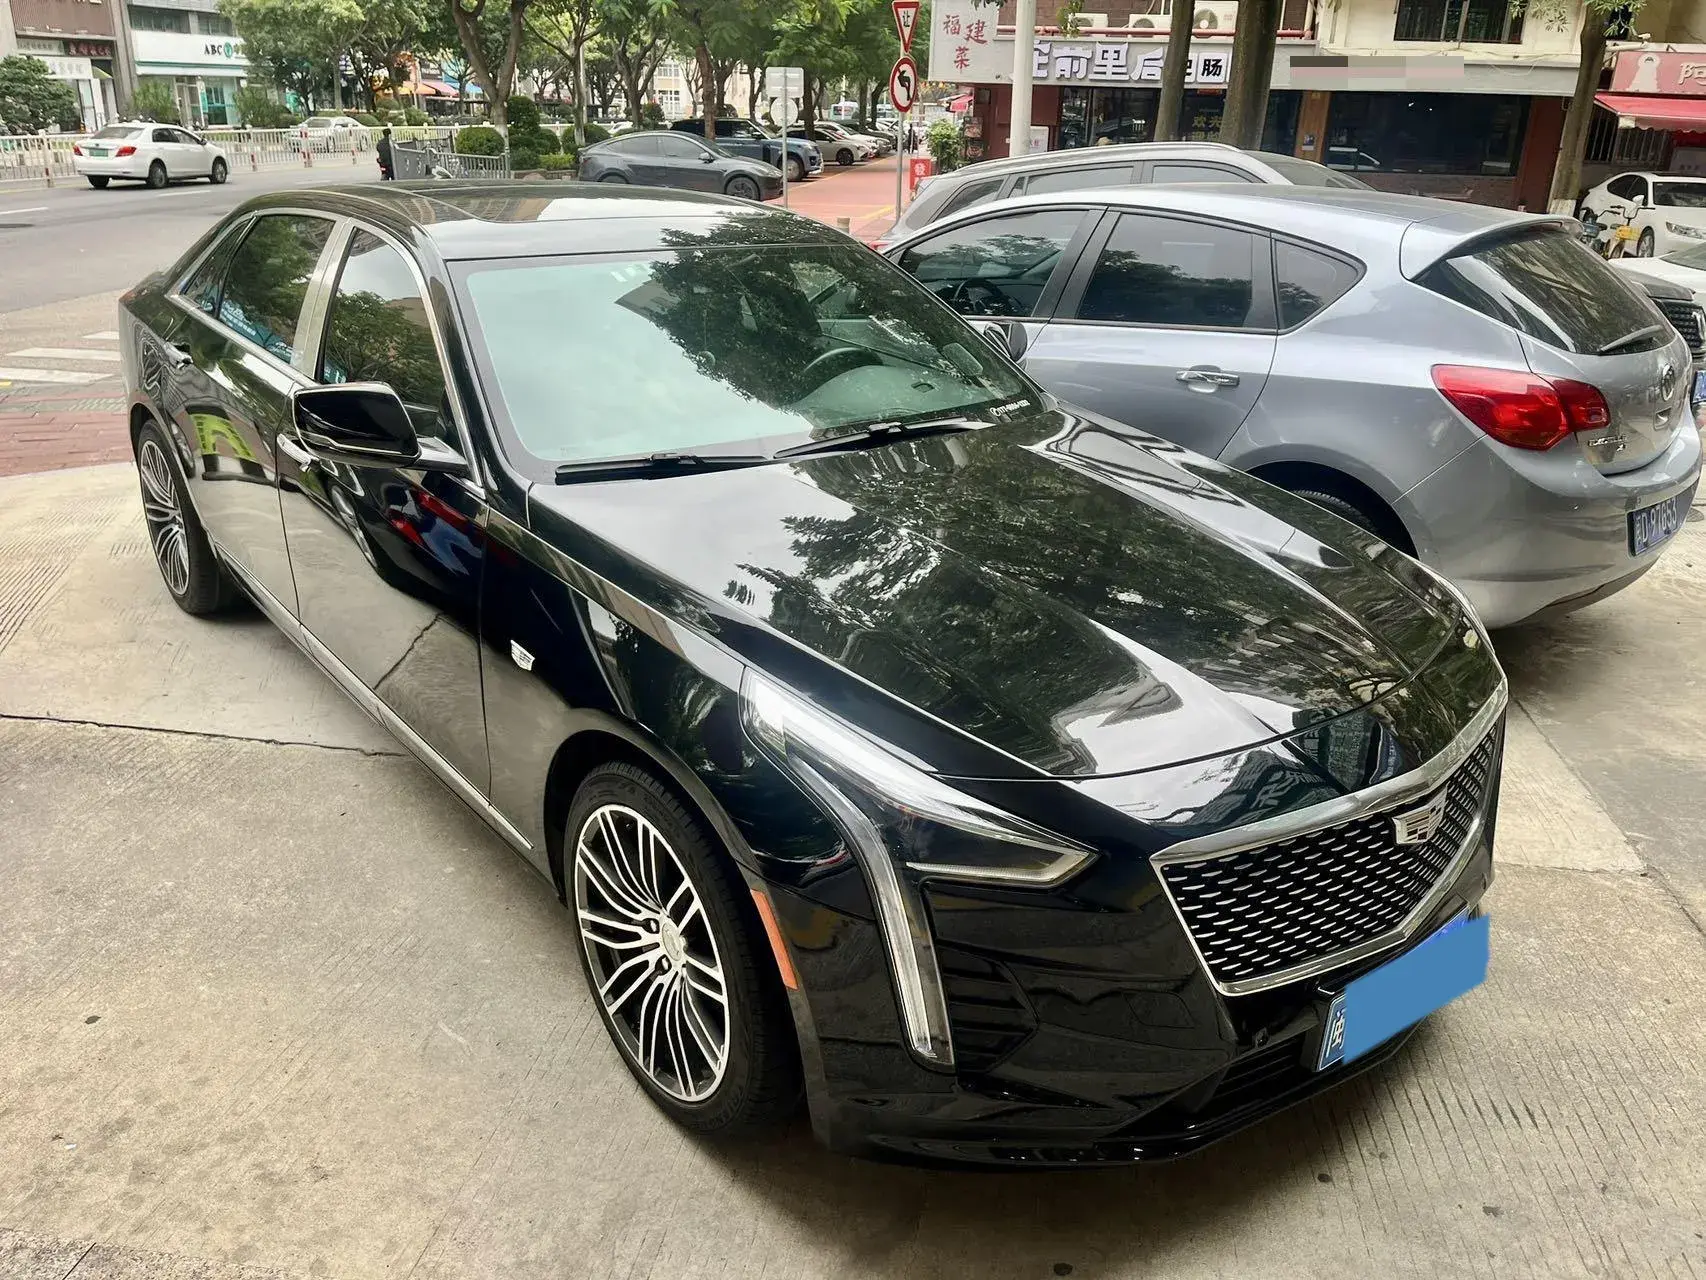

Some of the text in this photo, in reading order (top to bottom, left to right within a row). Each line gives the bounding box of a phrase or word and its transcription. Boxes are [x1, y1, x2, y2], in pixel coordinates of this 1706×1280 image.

[902, 10, 911, 28] 让
[943, 14, 988, 45] 福建
[204, 44, 223, 56] ABC
[953, 46, 970, 72] 菜
